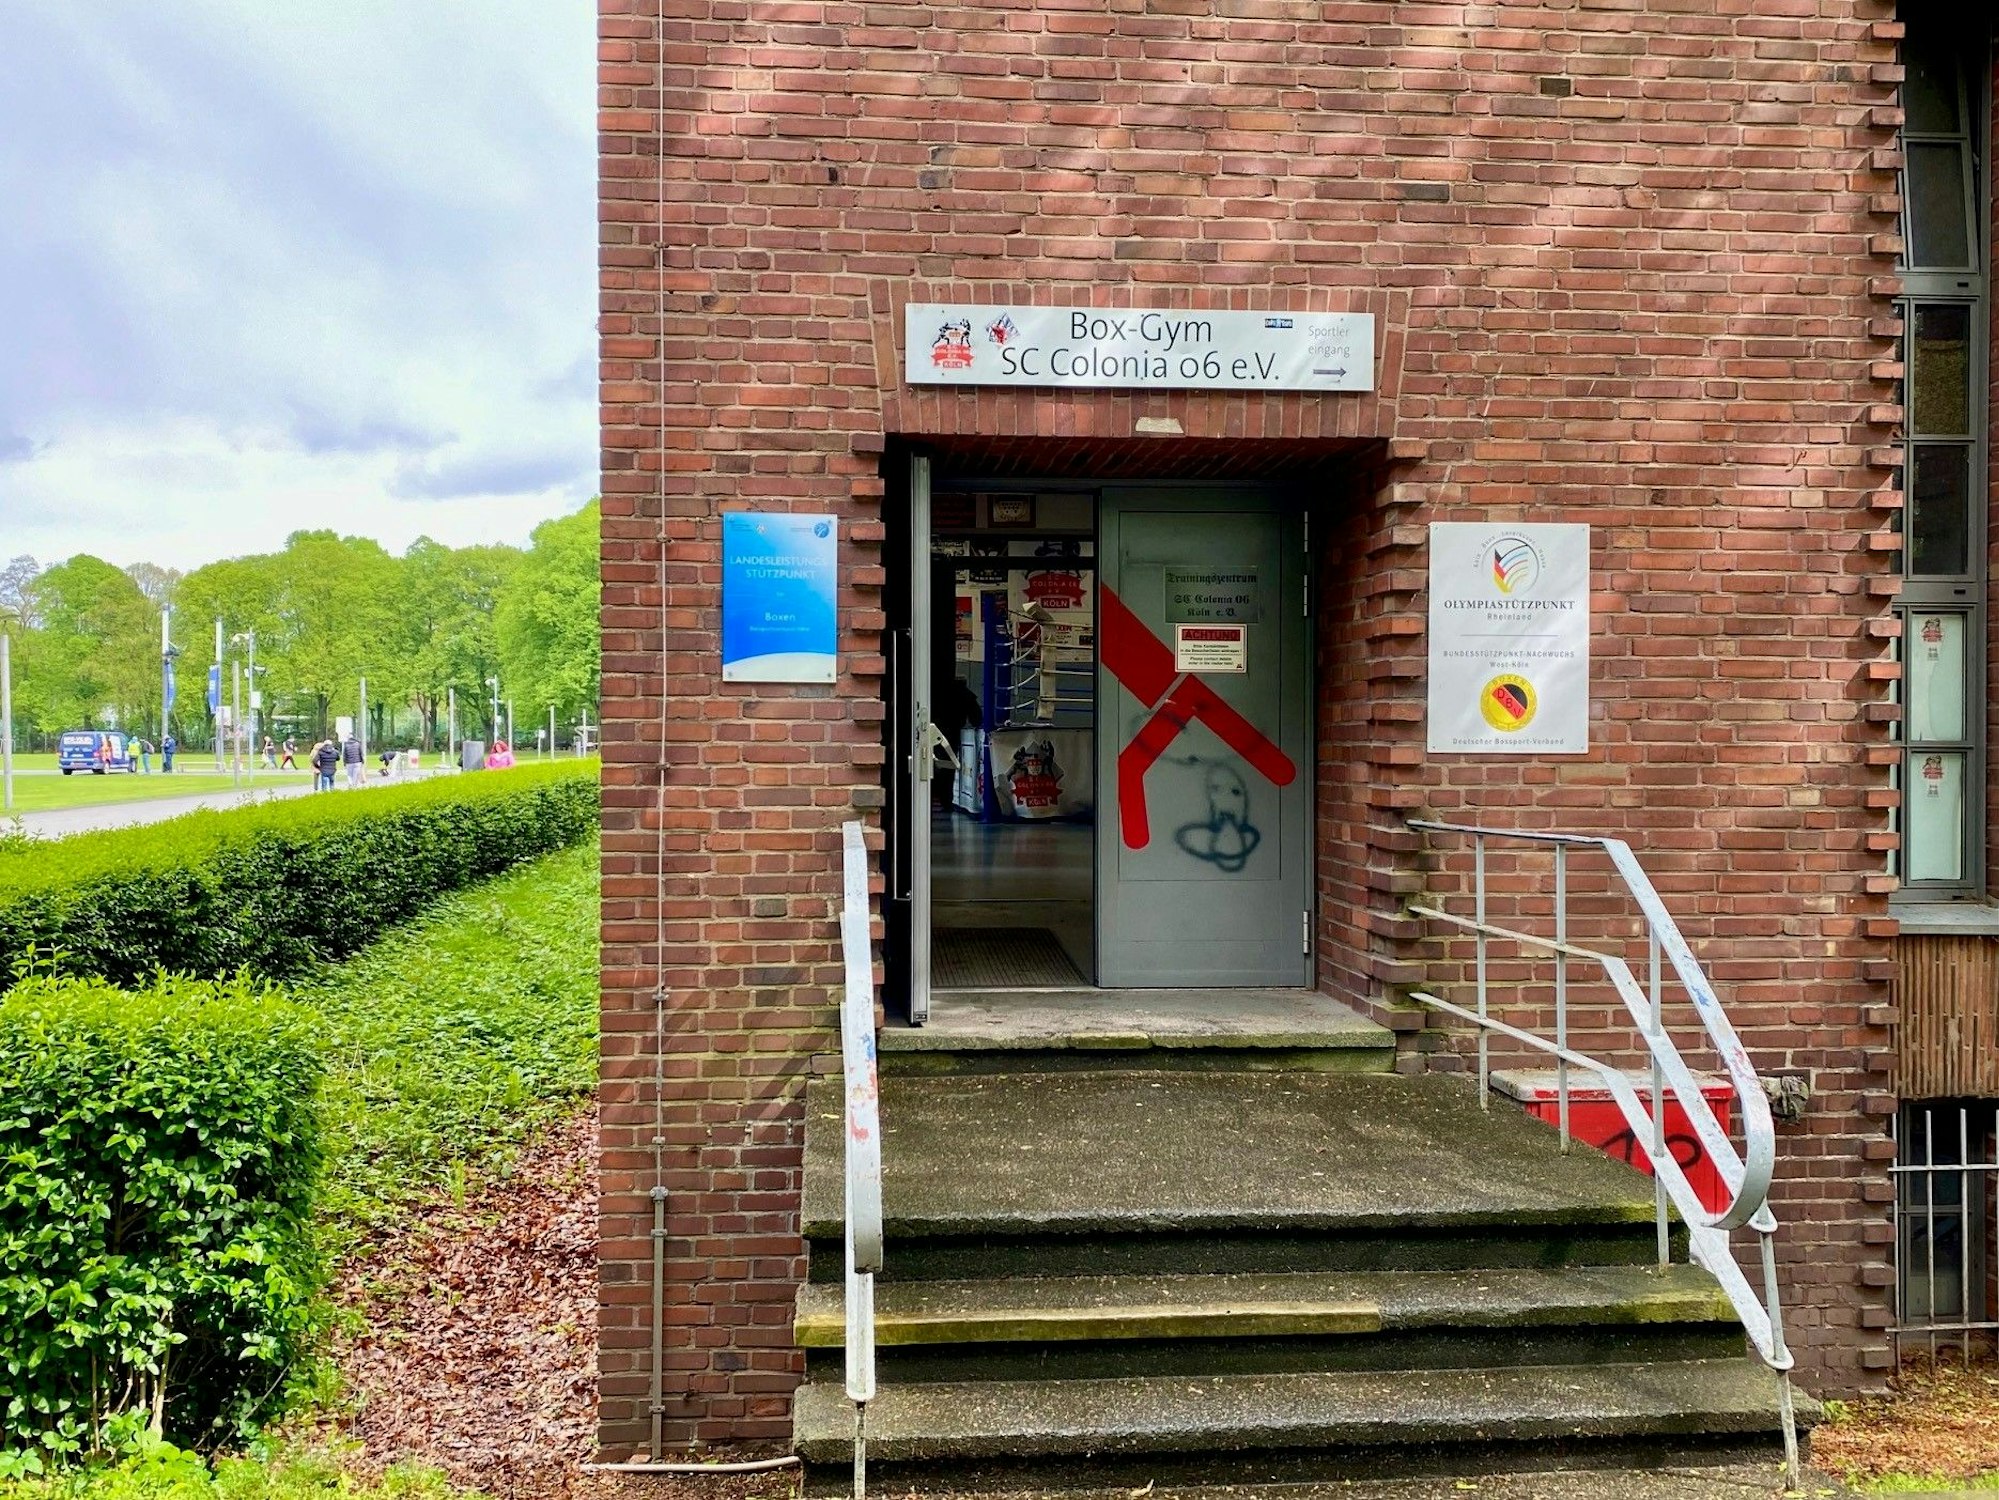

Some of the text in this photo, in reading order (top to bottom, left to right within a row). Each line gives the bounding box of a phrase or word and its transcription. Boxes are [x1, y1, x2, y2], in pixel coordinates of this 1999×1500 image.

[1070, 312, 1211, 351] Box-Gym
[1308, 325, 1350, 339] Sportler
[1308, 345, 1350, 358] eingang
[1001, 347, 1039, 376] SC
[1050, 349, 1167, 379] Colonia
[1231, 352, 1280, 381] e.V.
[1167, 572, 1257, 585] Trainingszentrum
[1174, 594, 1192, 604] SC
[1195, 594, 1232, 604] Colonia
[1444, 599, 1576, 610] OLYMPIASTÜTZPUNKT
[764, 612, 796, 622] Boxen
[1487, 613, 1532, 621] Rheinland
